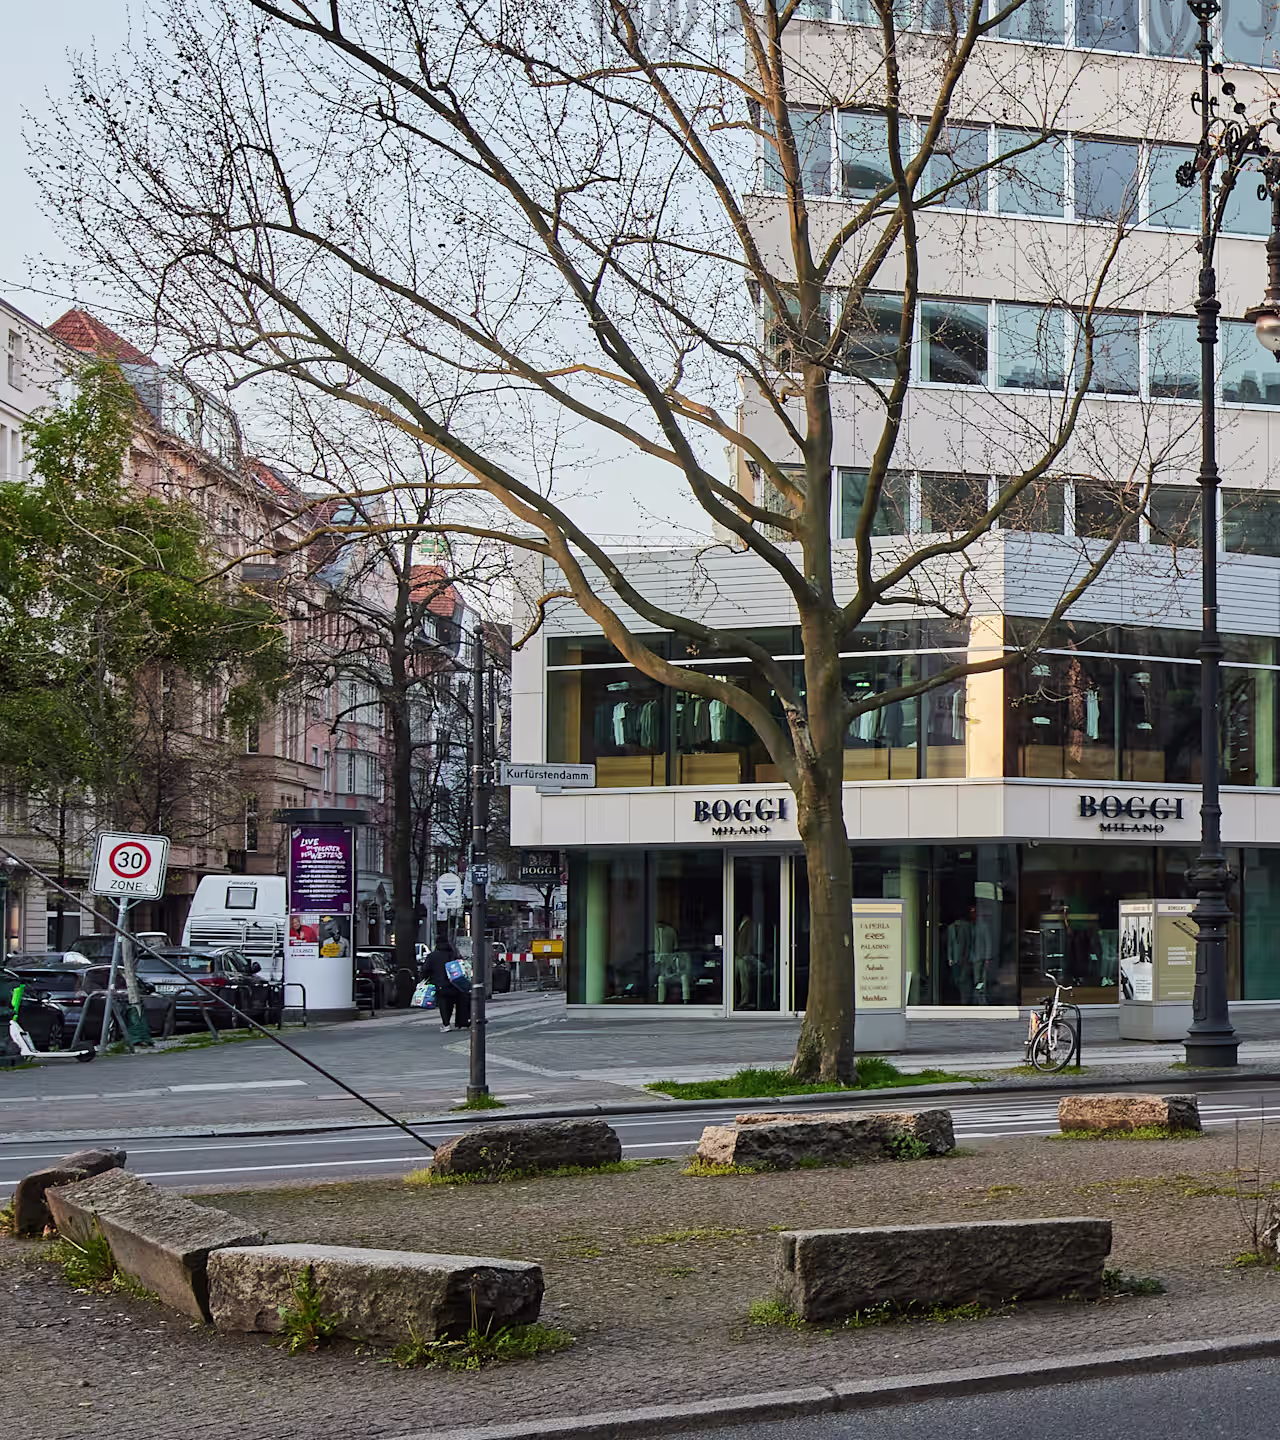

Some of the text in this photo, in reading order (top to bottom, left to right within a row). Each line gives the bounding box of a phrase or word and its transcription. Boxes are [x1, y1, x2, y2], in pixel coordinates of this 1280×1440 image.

[506, 768, 589, 780] Kurfürstendamm
[693, 797, 787, 822] BOGGI
[1079, 795, 1185, 820] BOGGI
[712, 824, 769, 835] MILANO
[1099, 823, 1164, 833] MILANO
[300, 838, 319, 847] LIVE
[117, 851, 143, 869] 30
[522, 867, 557, 875] BOGGI
[110, 879, 142, 892] ZONE
